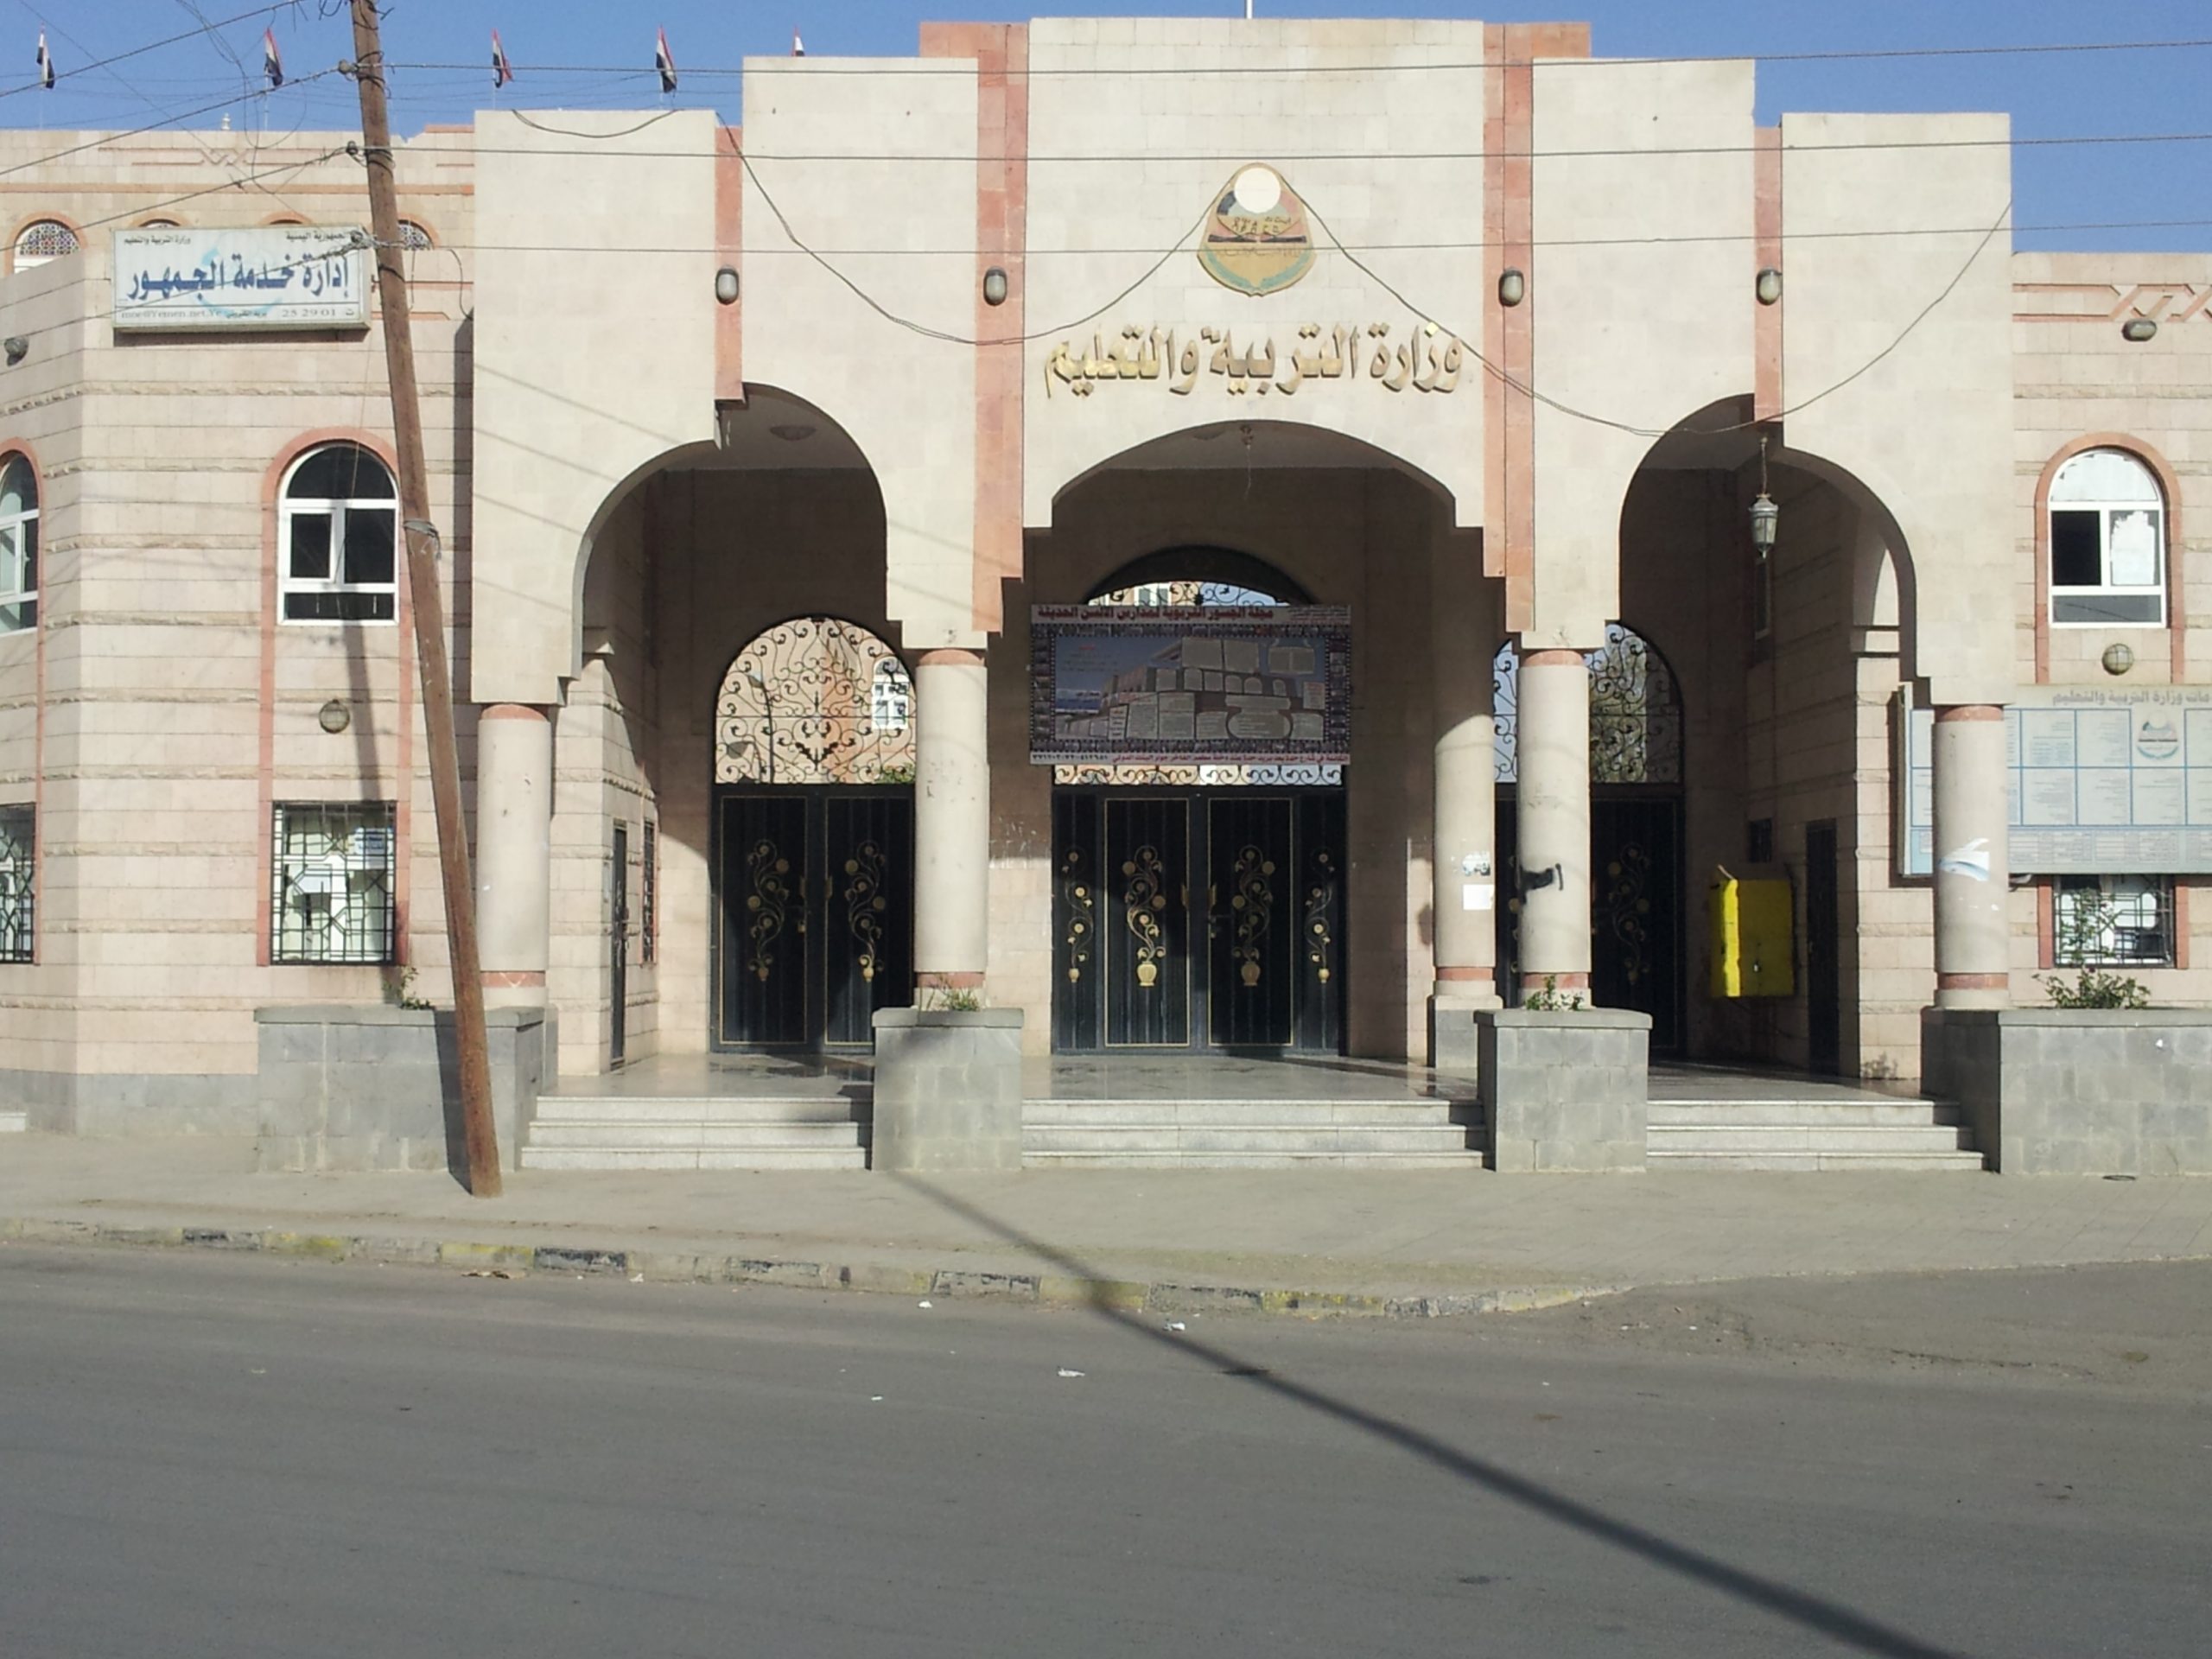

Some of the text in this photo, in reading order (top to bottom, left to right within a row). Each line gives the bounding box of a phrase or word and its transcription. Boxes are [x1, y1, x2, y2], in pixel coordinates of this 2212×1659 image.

[127, 259, 225, 301] الجمهور
[231, 252, 296, 290] خدمة
[302, 309, 319, 318] 29
[1044, 321, 1465, 399] وزارة التربية والتعليم
